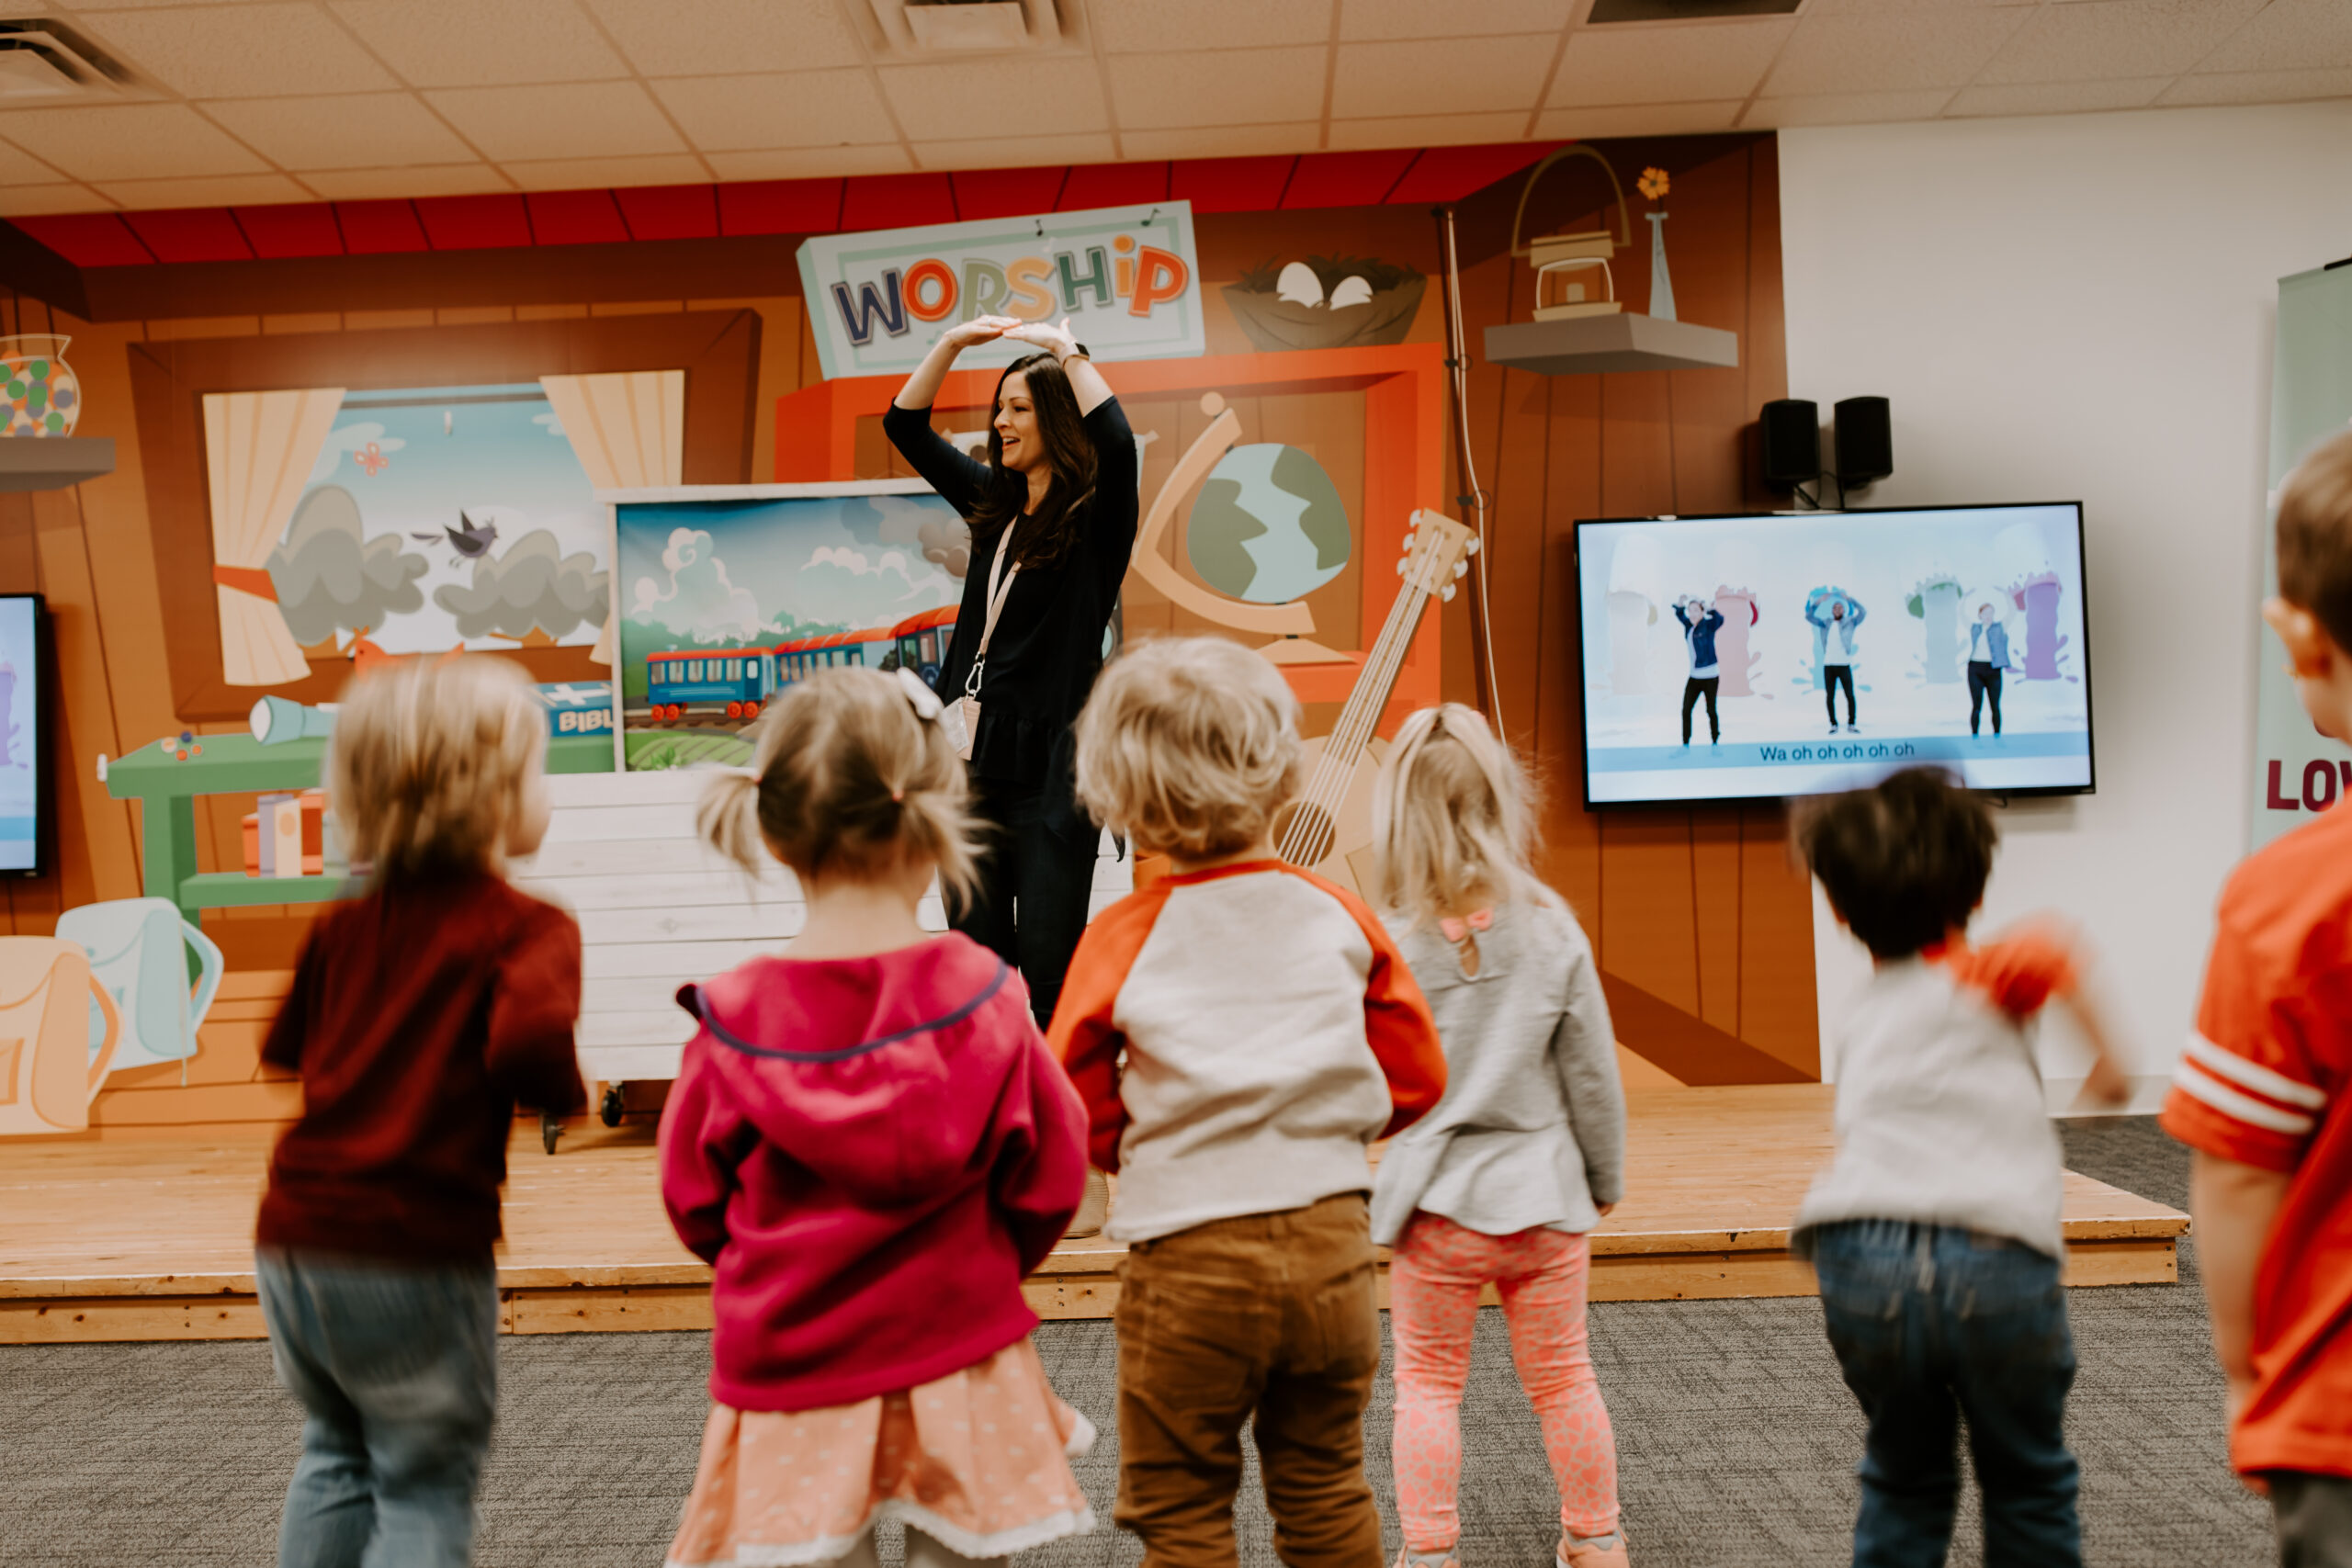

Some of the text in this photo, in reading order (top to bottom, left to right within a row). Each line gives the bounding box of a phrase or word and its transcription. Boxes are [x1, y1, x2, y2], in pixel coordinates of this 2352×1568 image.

[1760, 741, 1915, 761] Wa oh oh oh oh oh
